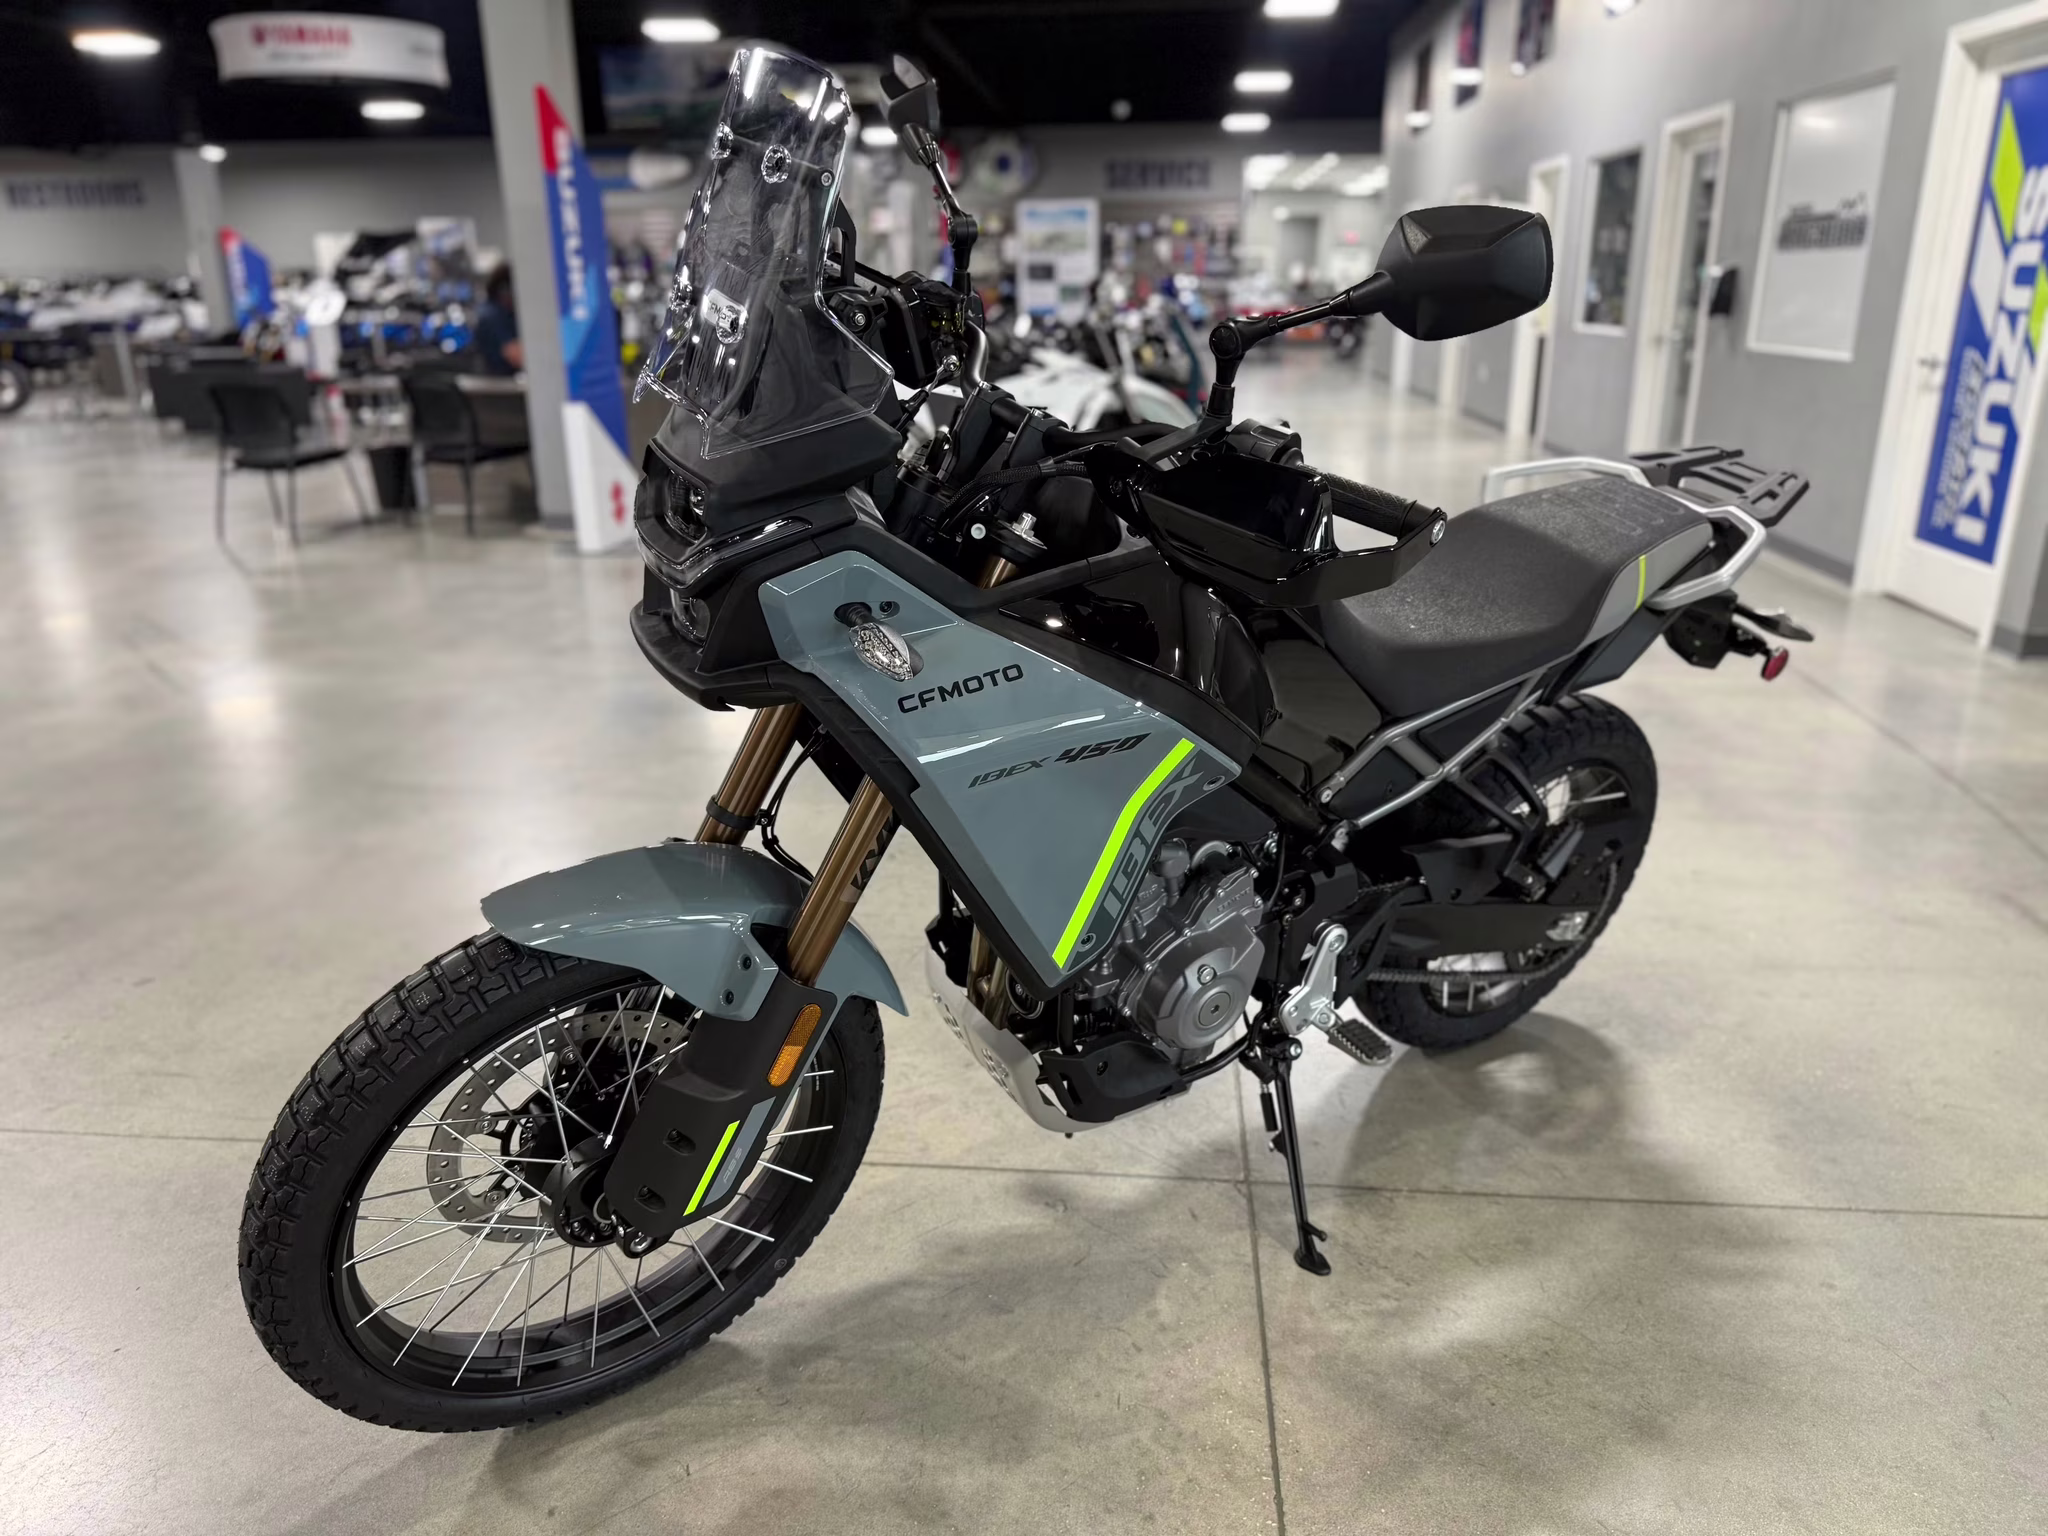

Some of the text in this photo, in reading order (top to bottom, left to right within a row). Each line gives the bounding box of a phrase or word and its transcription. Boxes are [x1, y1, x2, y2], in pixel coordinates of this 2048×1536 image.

[1954, 162, 2048, 547] SUZUKI
[897, 663, 1024, 714] CFMOTO
[968, 732, 1152, 789] IBEX 450
[1103, 757, 1204, 919] IBEX
